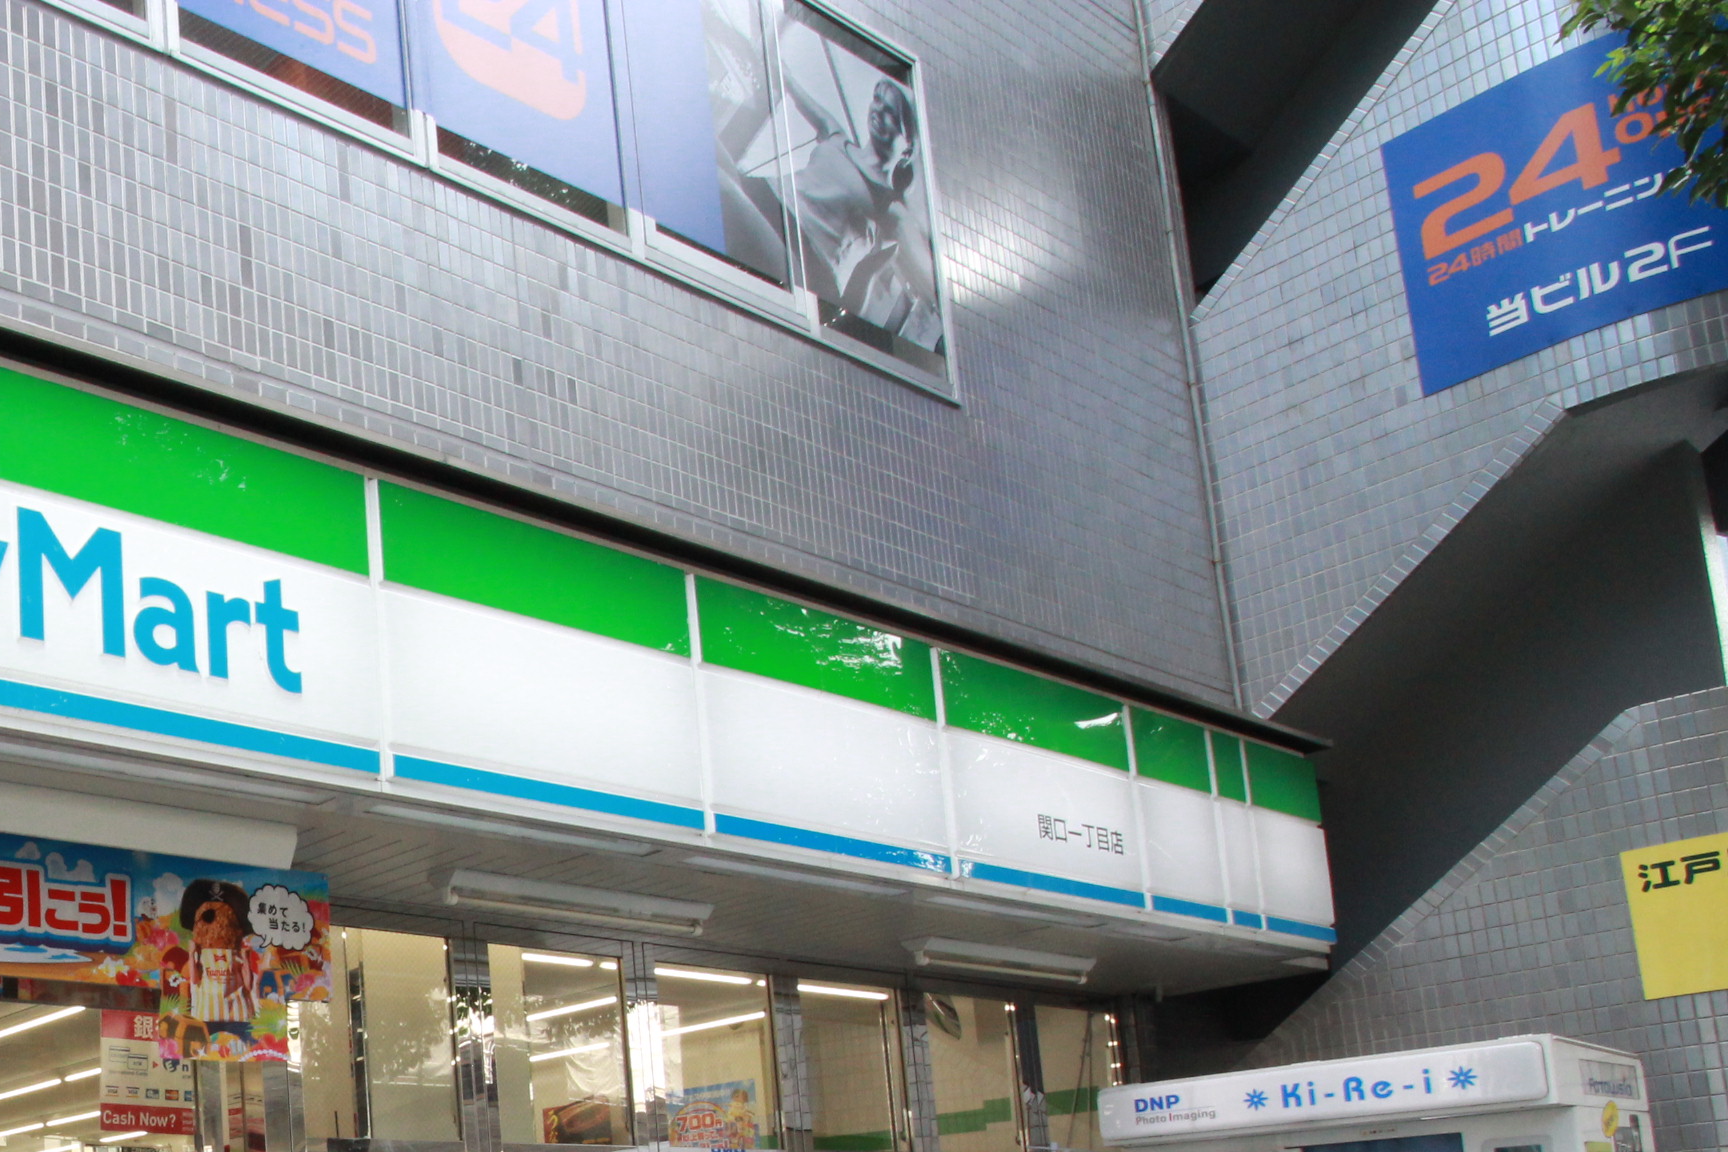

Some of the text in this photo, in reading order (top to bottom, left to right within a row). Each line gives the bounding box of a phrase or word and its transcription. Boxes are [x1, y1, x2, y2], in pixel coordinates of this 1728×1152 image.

[1413, 102, 1622, 260] 24
[1486, 226, 1714, 337] 当ビル2F
[1037, 813, 1124, 856] 関口一丁目店
[1638, 849, 1728, 893] 江戸
[257, 902, 289, 918] 集めて
[269, 919, 306, 933] 当たる!
[133, 1014, 160, 1039] 銀
[1280, 1067, 1433, 1109] Ki-Re-i
[1134, 1094, 1181, 1114] DNP
[103, 1110, 135, 1125] Cash
[140, 1113, 176, 1128] Now?
[676, 1113, 723, 1132] 700円
[1135, 1108, 1216, 1126] Photo Imaging
